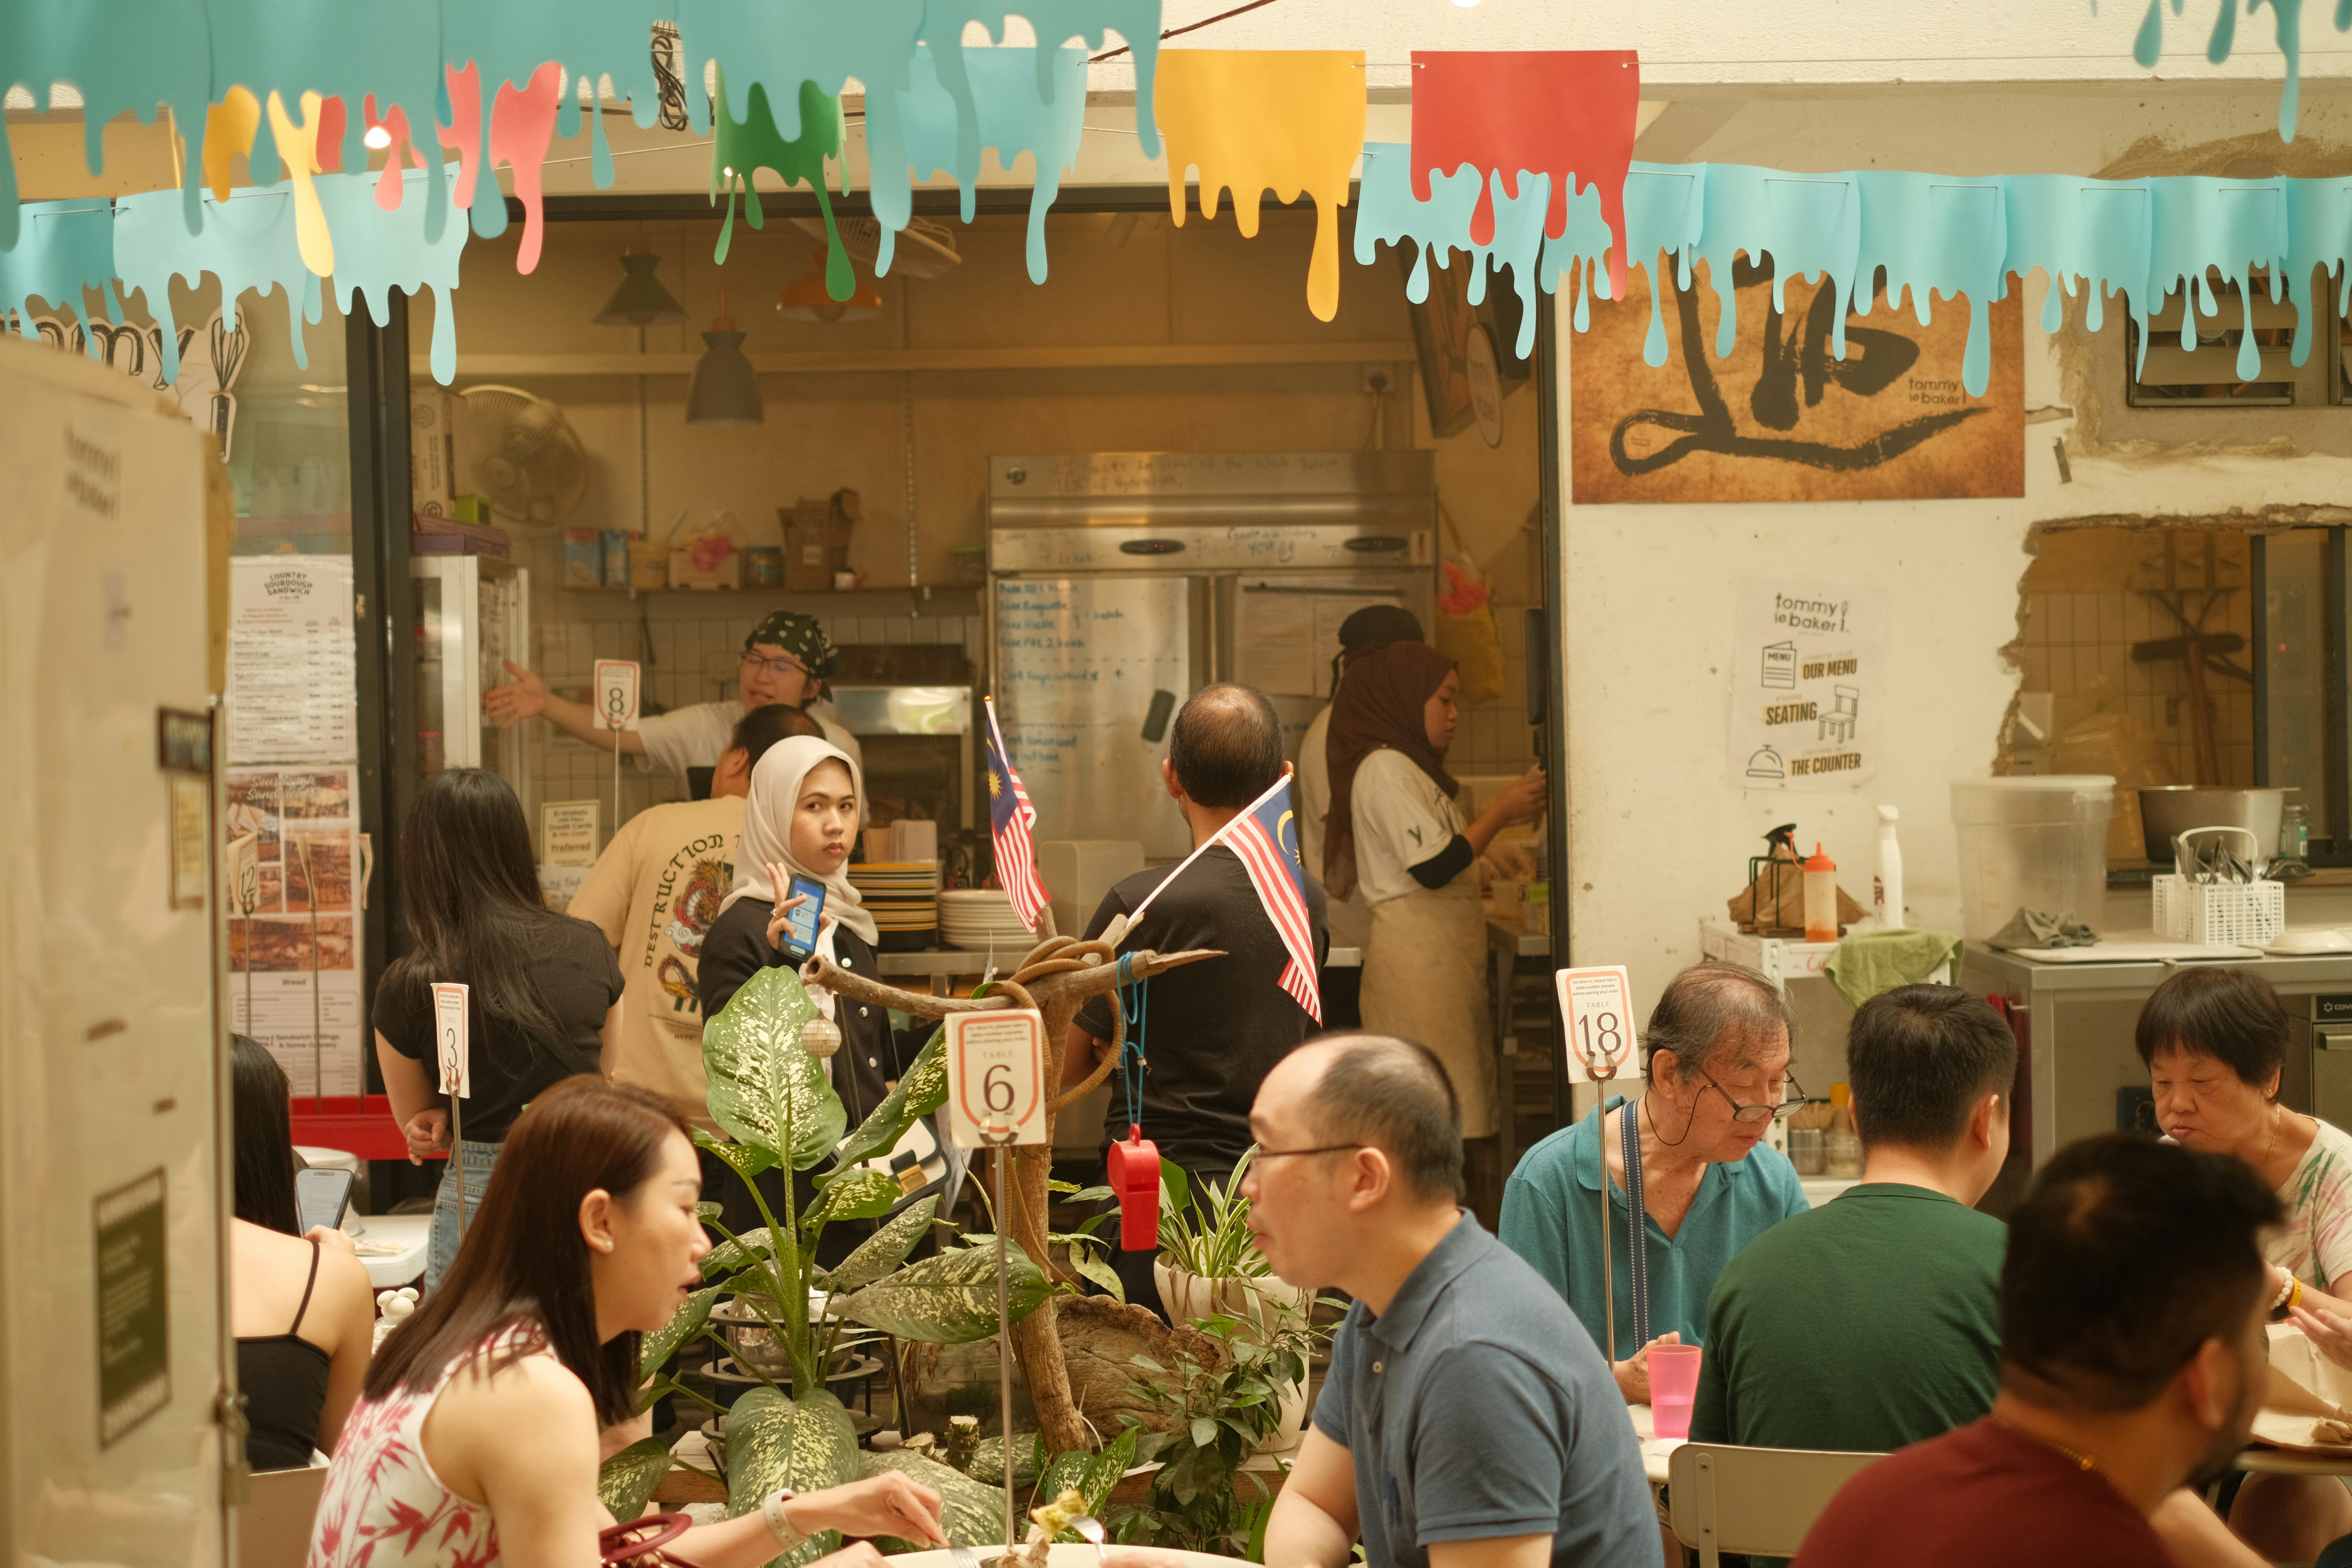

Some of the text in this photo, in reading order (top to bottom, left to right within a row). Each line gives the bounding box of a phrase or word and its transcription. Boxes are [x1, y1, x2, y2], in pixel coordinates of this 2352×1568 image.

[1909, 377, 1959, 392] tommy
[1922, 392, 1960, 404] baker
[264, 580, 313, 590] SOURDOUGH
[270, 572, 306, 580] COUNTRY
[267, 588, 309, 596] SANDWICH
[1776, 593, 1838, 617] tommy
[1789, 612, 1836, 632] baker
[1768, 652, 1791, 662] MENU
[1803, 658, 1857, 680] OUR MENU
[609, 687, 624, 713] 8
[1766, 702, 1818, 725] SEATING
[1792, 753, 1861, 776] THE COUNTER
[251, 774, 315, 789] Sourdough
[551, 842, 590, 852] Preferred
[241, 866, 255, 897] 12
[644, 834, 724, 968] DESTRUCTION
[1578, 1012, 1622, 1055] 18
[446, 1027, 457, 1068] 3
[983, 1050, 1013, 1059] TABLE
[983, 1064, 1015, 1112] 6
